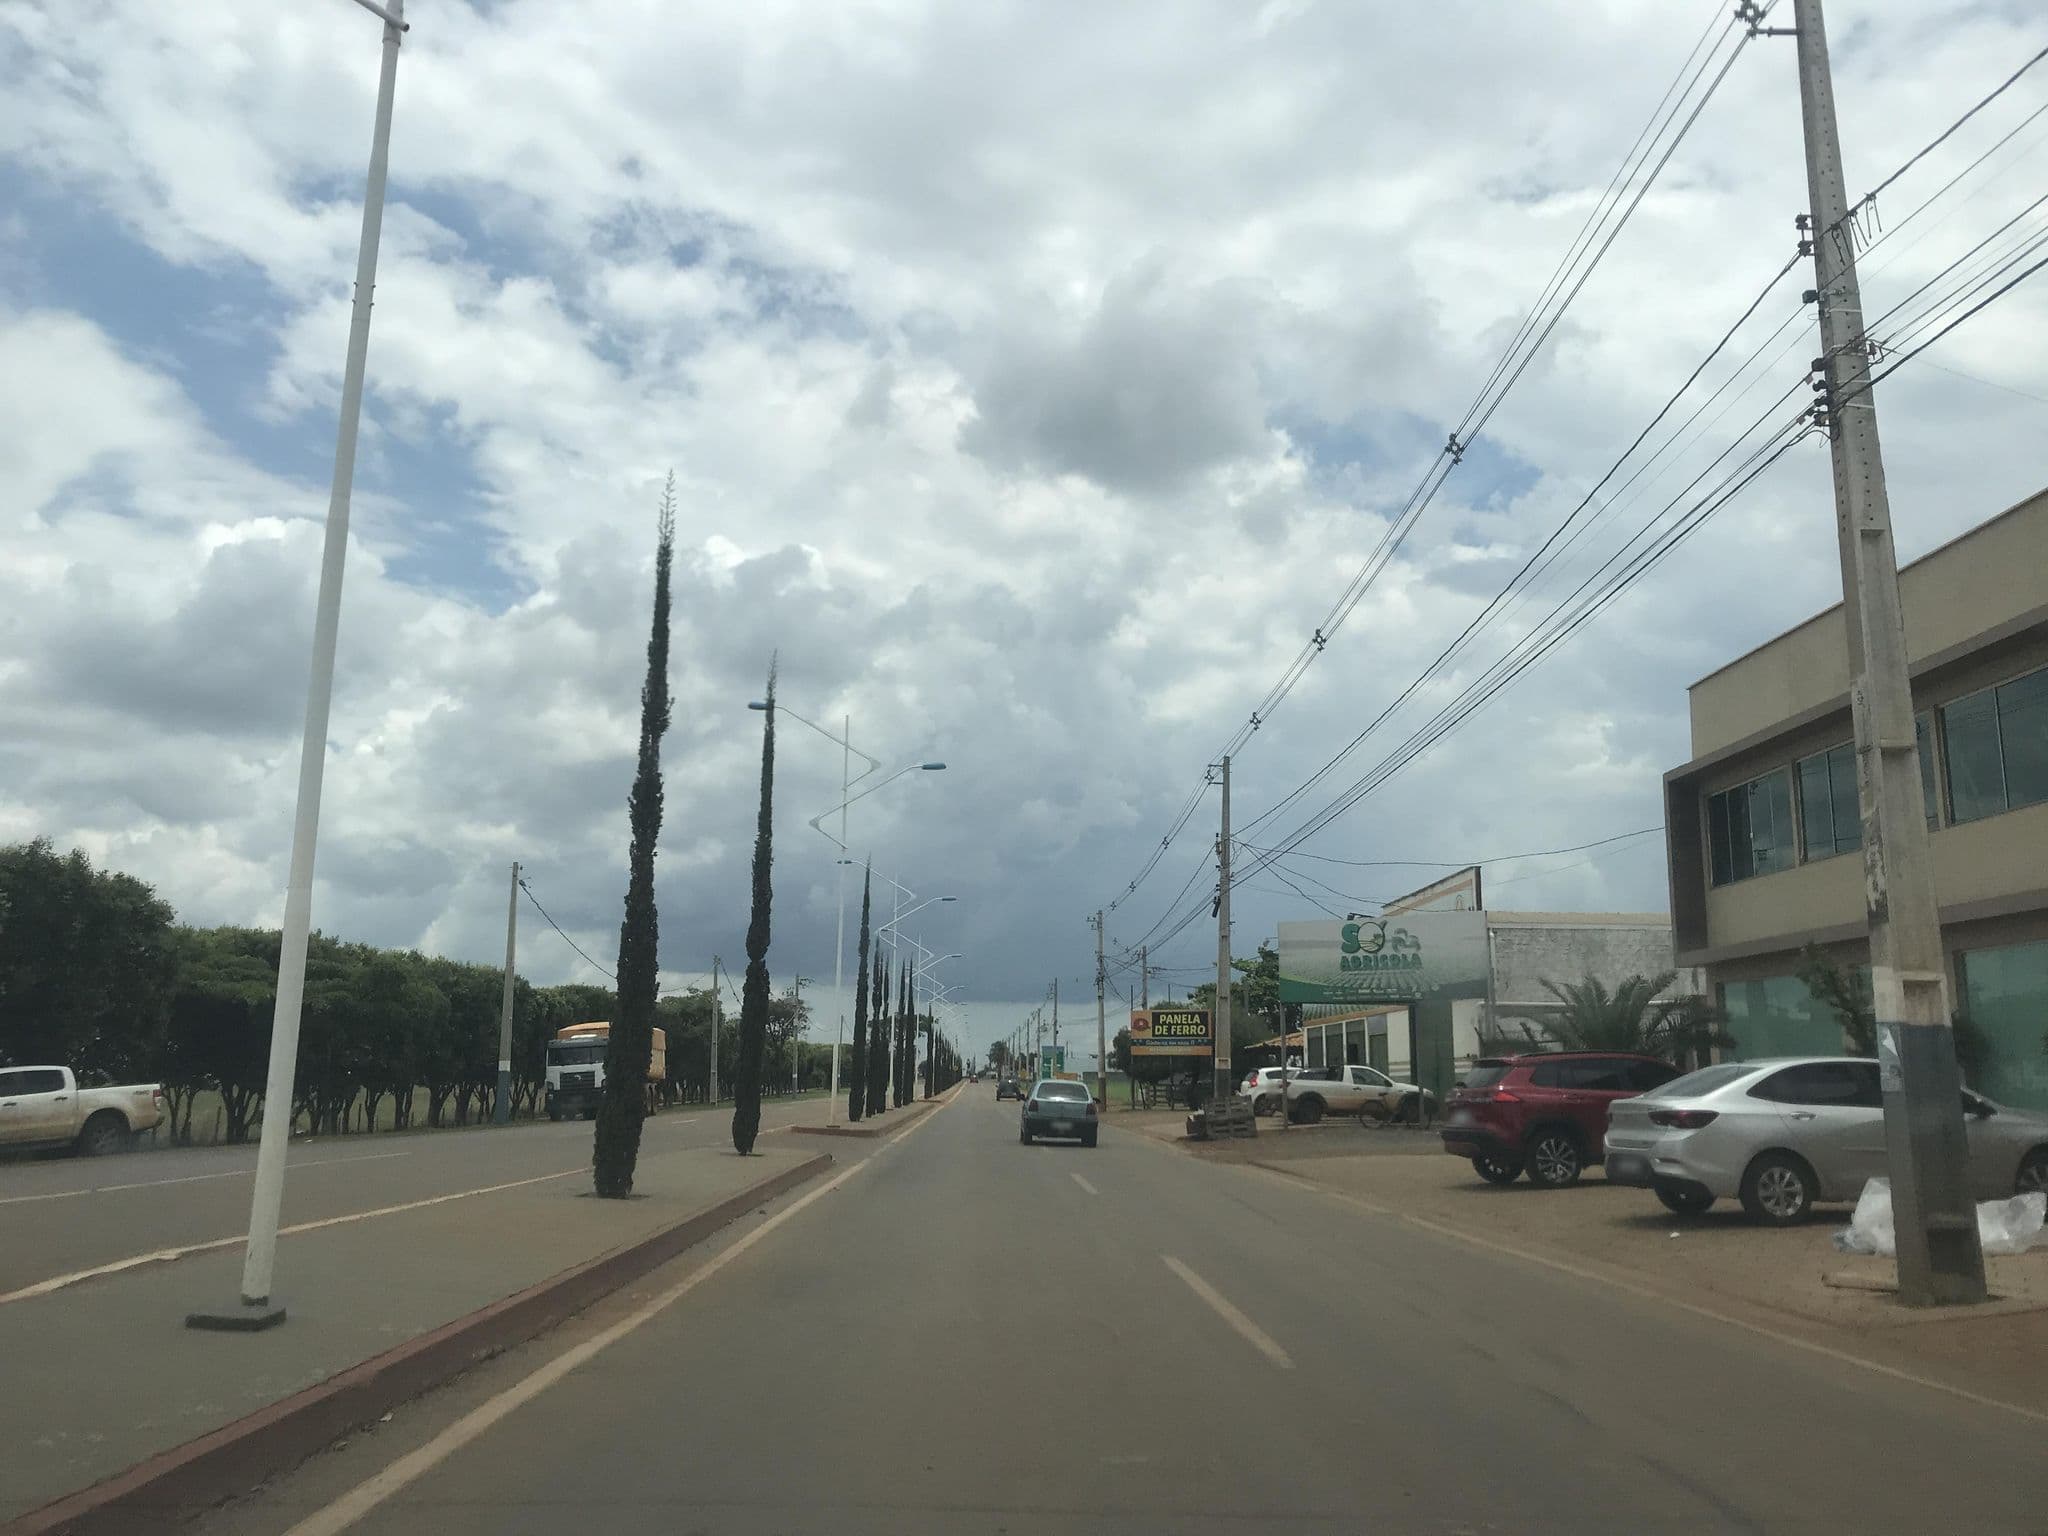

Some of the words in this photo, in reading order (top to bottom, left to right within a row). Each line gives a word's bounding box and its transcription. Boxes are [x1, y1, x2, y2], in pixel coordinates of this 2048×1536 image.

[1159, 1014, 1201, 1025] PANELA
[1155, 1025, 1168, 1035] DE
[1171, 1025, 1206, 1035] FERRO
